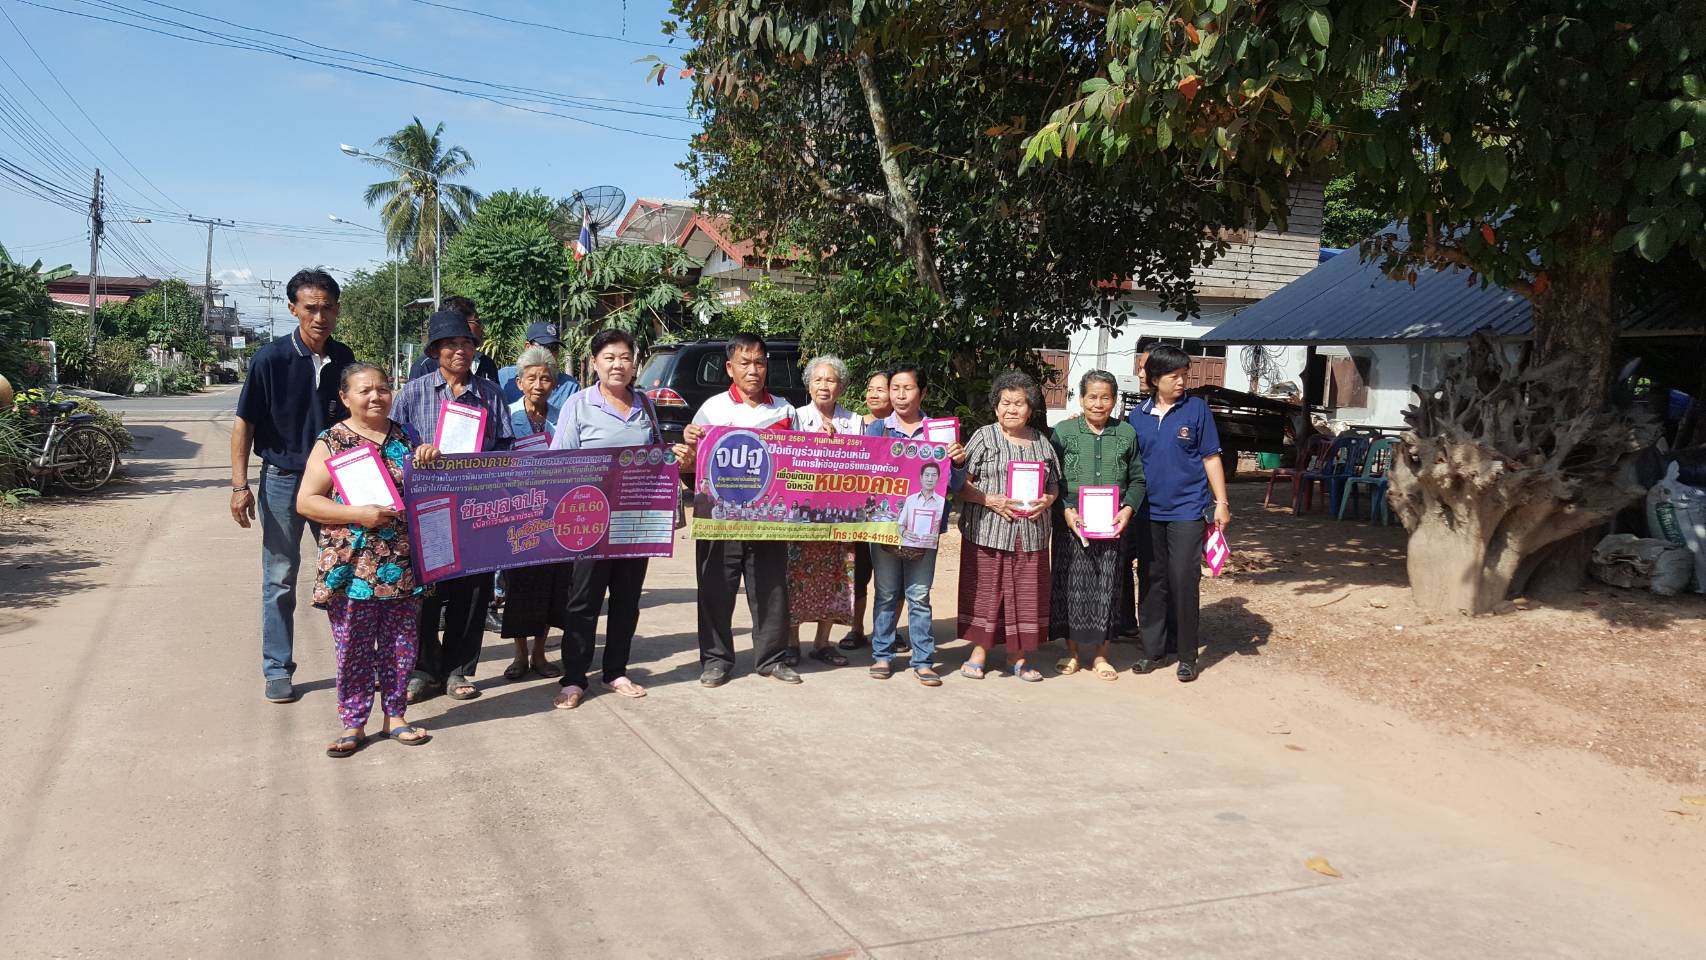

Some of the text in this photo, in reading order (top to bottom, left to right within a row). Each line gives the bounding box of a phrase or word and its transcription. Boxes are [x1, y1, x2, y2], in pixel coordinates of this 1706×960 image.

[815, 474, 909, 495] หนองคาย
[461, 498, 511, 520] ข้อมูล
[852, 531, 899, 544] 042-411182
